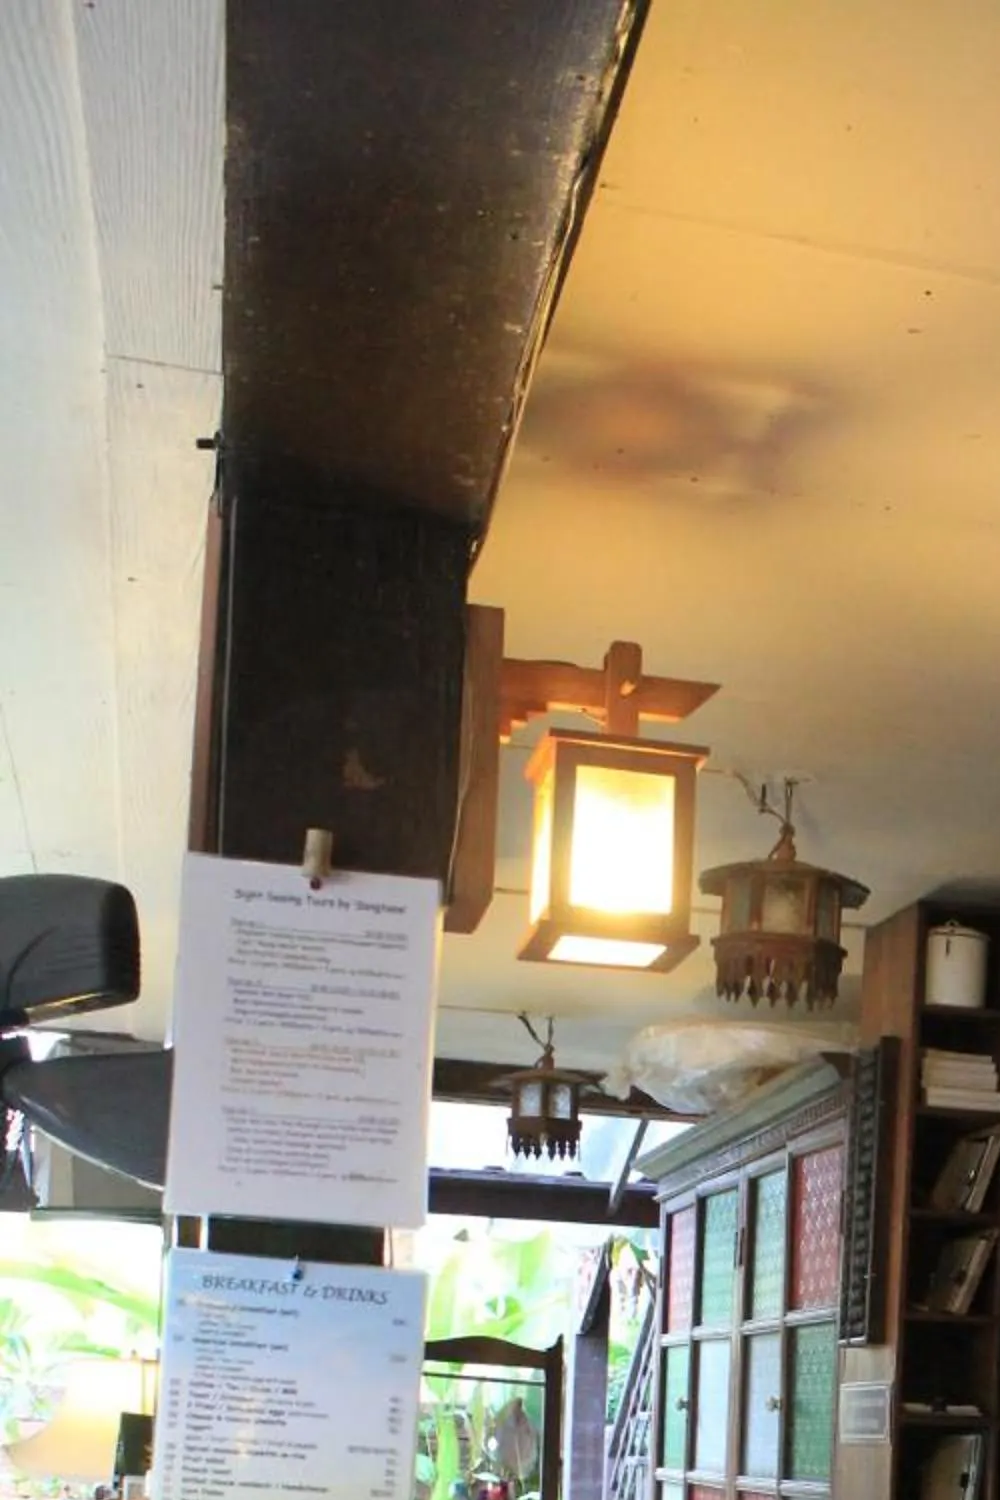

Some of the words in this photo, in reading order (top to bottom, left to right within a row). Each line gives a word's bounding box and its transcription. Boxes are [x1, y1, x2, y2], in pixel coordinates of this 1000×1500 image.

[201, 1274, 300, 1296] BREAKFAST
[303, 1286, 318, 1298] &
[322, 1286, 392, 1305] DRINKS
